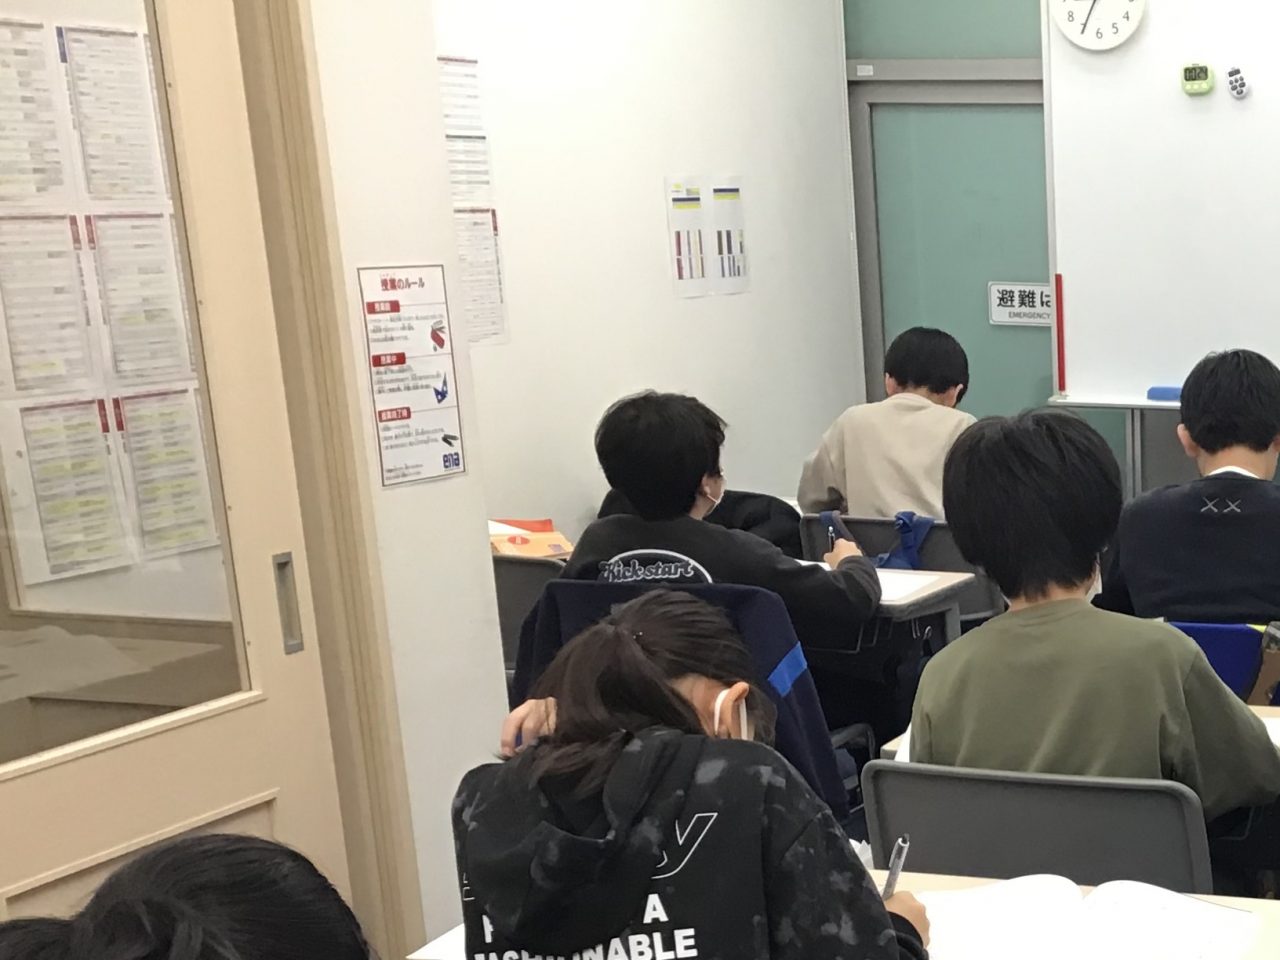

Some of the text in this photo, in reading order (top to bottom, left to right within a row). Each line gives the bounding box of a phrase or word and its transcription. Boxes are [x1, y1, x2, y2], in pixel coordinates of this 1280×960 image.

[1067, 10, 1075, 22] 8
[1122, 10, 1130, 21] 4
[1095, 27, 1103, 39] 6
[1111, 22, 1119, 34] 5
[643, 893, 669, 924] A
